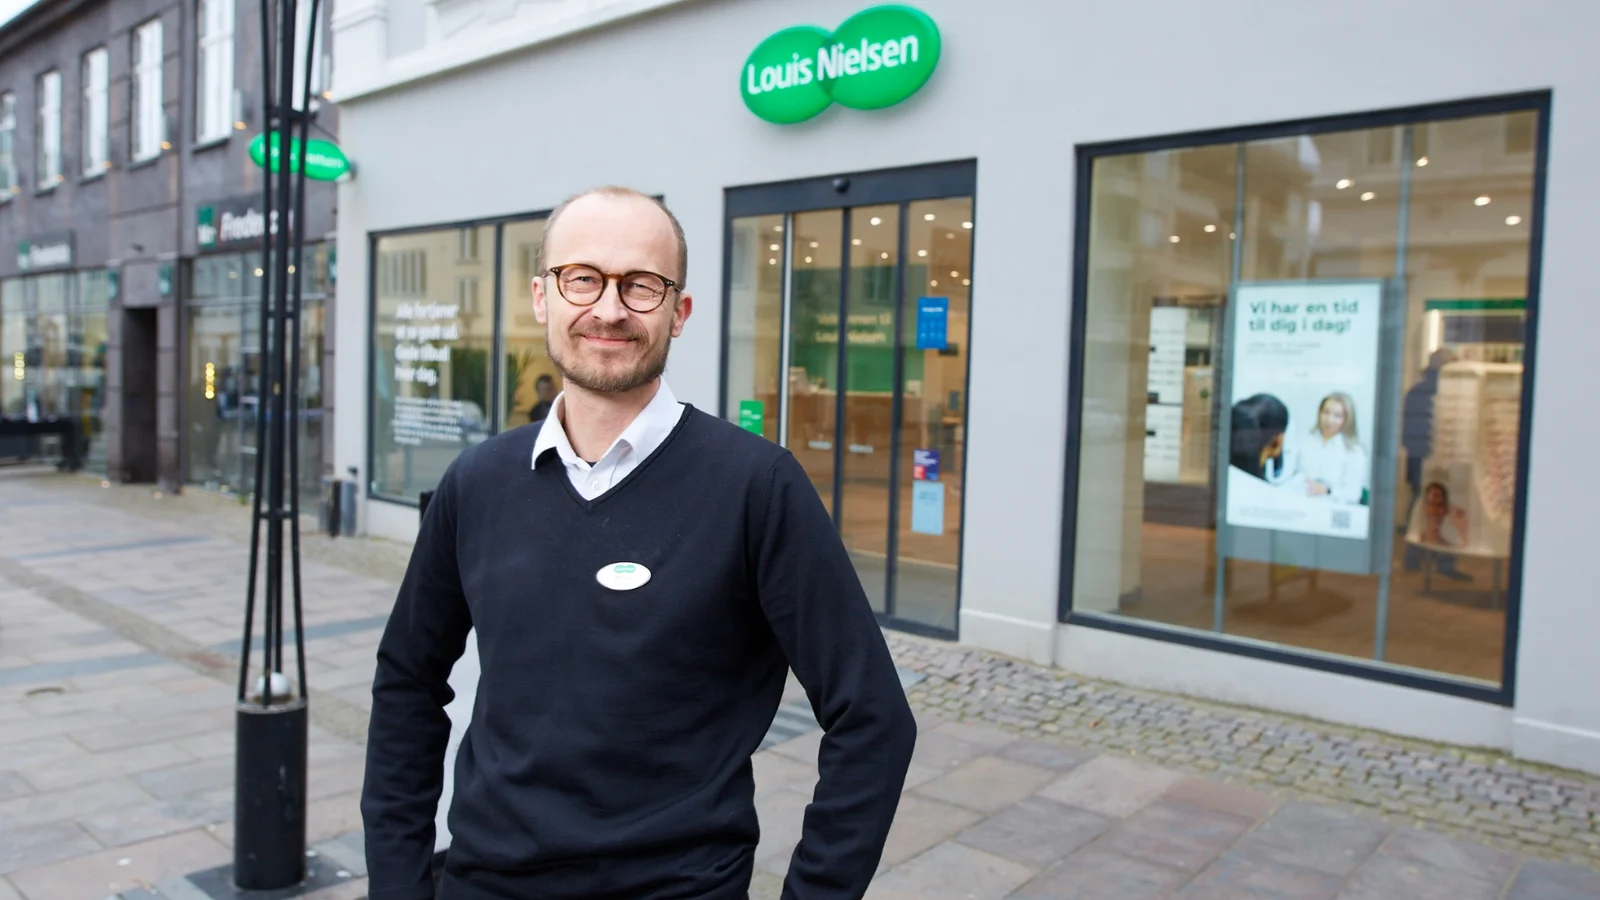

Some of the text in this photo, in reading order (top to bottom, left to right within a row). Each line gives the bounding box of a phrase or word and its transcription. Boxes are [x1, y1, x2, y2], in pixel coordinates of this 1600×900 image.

[747, 35, 918, 94] Louis Nielsen
[1250, 299, 1358, 314] Vi har en tid
[1249, 317, 1265, 331] til
[1270, 317, 1297, 334] dig
[1312, 317, 1350, 335] dag!
